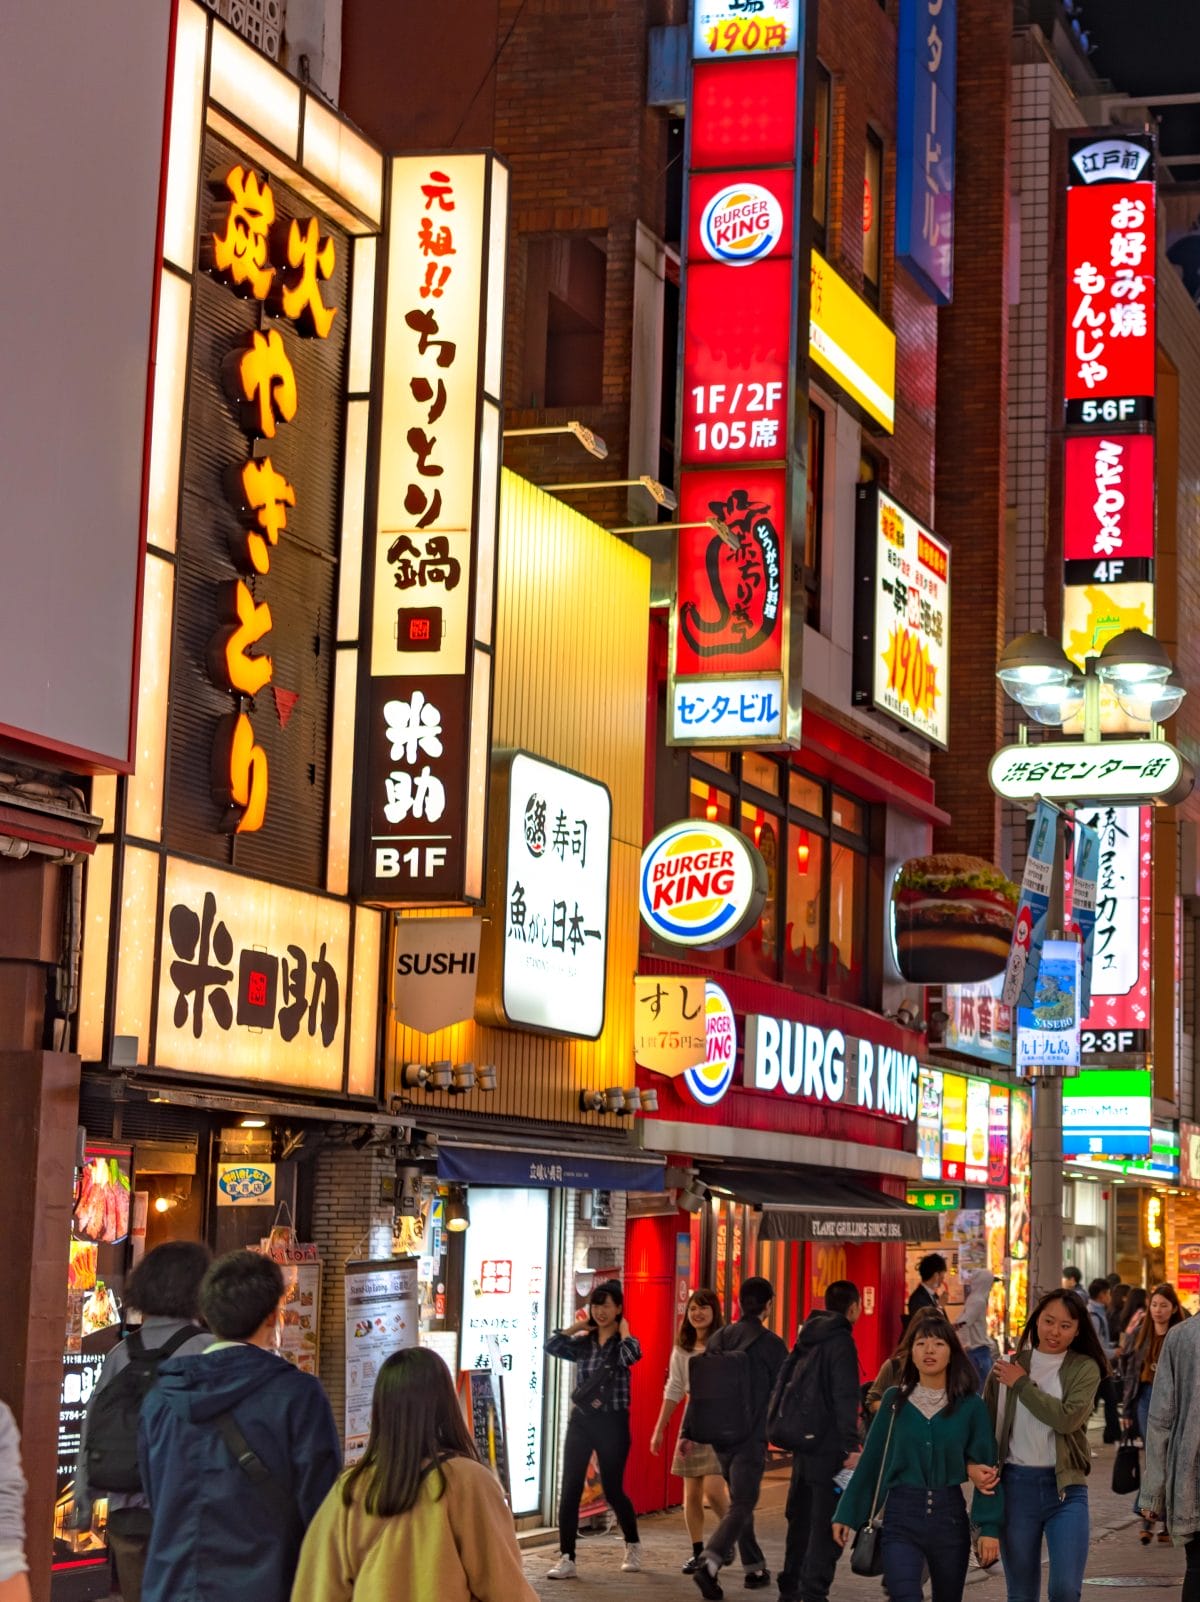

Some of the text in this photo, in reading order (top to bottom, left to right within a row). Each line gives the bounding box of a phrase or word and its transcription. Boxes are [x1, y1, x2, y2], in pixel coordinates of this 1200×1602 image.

[710, 21, 788, 52] 190円
[1082, 149, 1140, 173] 江戸前
[713, 200, 769, 229] BURGER
[716, 213, 770, 247] KING
[1110, 198, 1147, 338] お好み焼
[1072, 262, 1108, 389] もんじゃ
[694, 418, 779, 451] 105席
[757, 525, 780, 620] とうがらし料理
[1093, 561, 1124, 582] 4F
[677, 693, 779, 725] センタービル
[1002, 758, 1171, 782] 渋谷センター街
[552, 809, 587, 868] 寿司
[375, 845, 447, 878] B1F
[652, 850, 734, 884] BURGER
[652, 869, 734, 911] KING
[507, 881, 602, 956] 魚がし日本一
[396, 951, 477, 977] SUSHI
[640, 983, 701, 1021] すし
[1033, 1017, 1074, 1029] SASEBO
[1020, 1039, 1070, 1056] 九十九島
[877, 1044, 919, 1121] KING
[836, 1221, 867, 1236] GRILLING
[868, 1222, 887, 1237] SINCE
